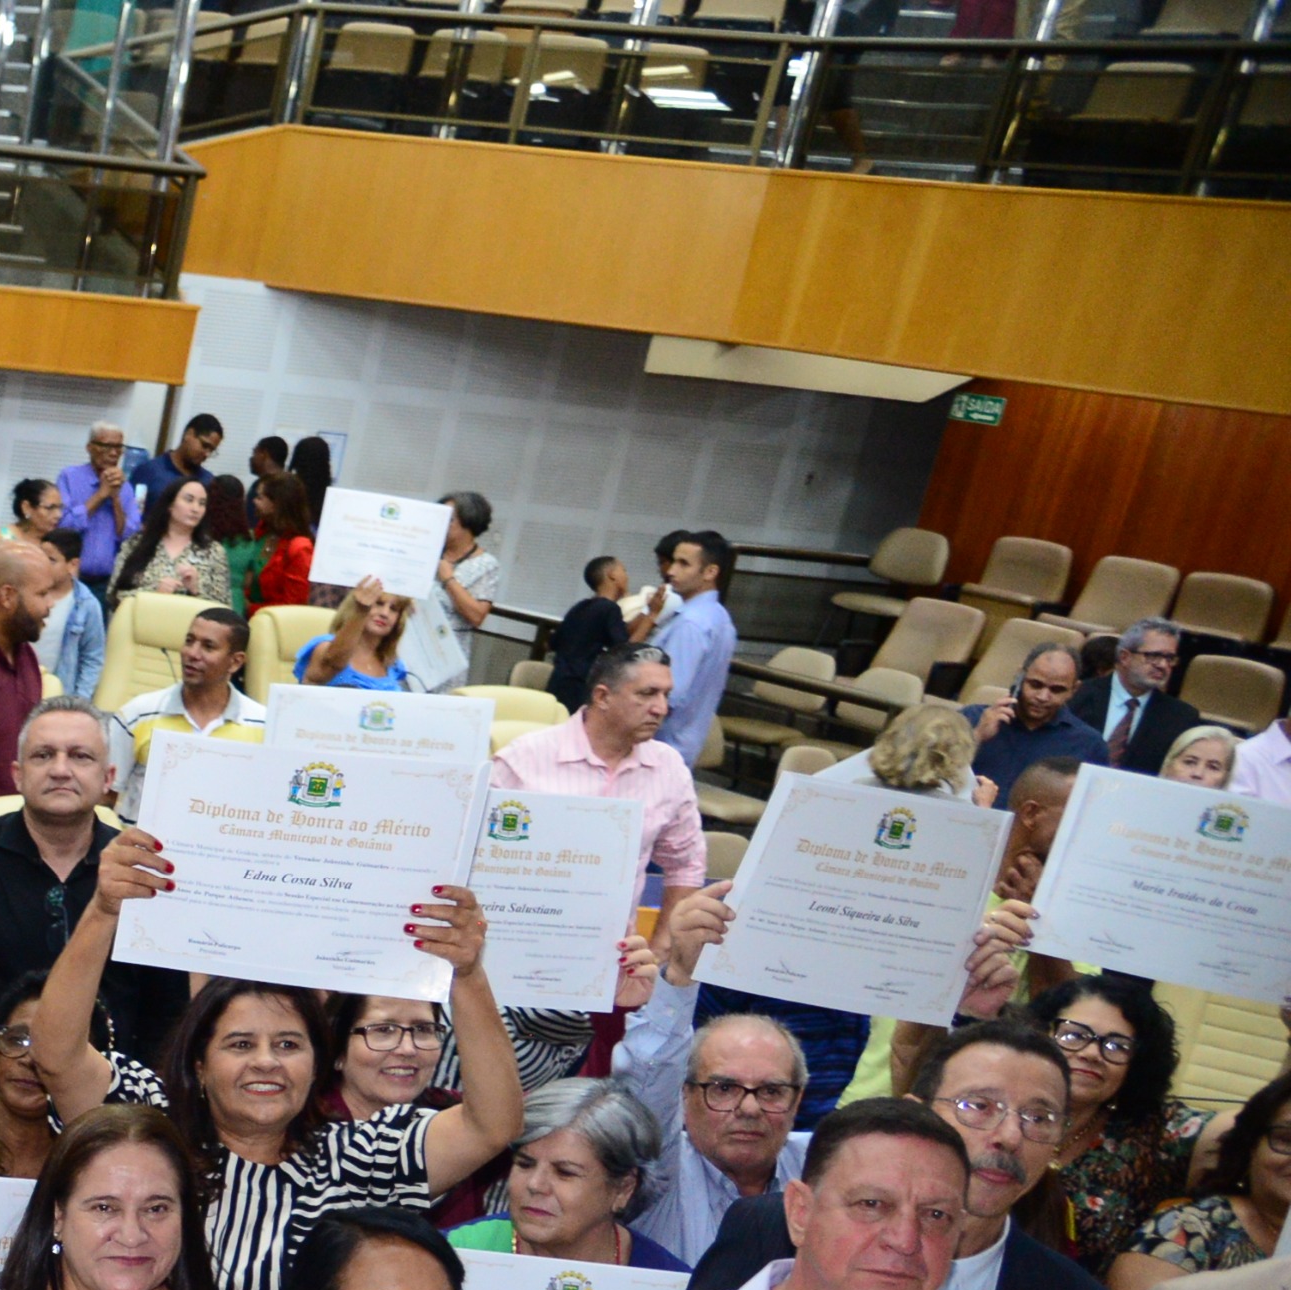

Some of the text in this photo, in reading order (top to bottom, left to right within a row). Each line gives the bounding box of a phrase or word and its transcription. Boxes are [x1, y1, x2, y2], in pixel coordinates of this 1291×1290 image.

[242, 869, 352, 889] Edna Costa Silva
[808, 900, 920, 928] Leoni Siqueira da Silva
